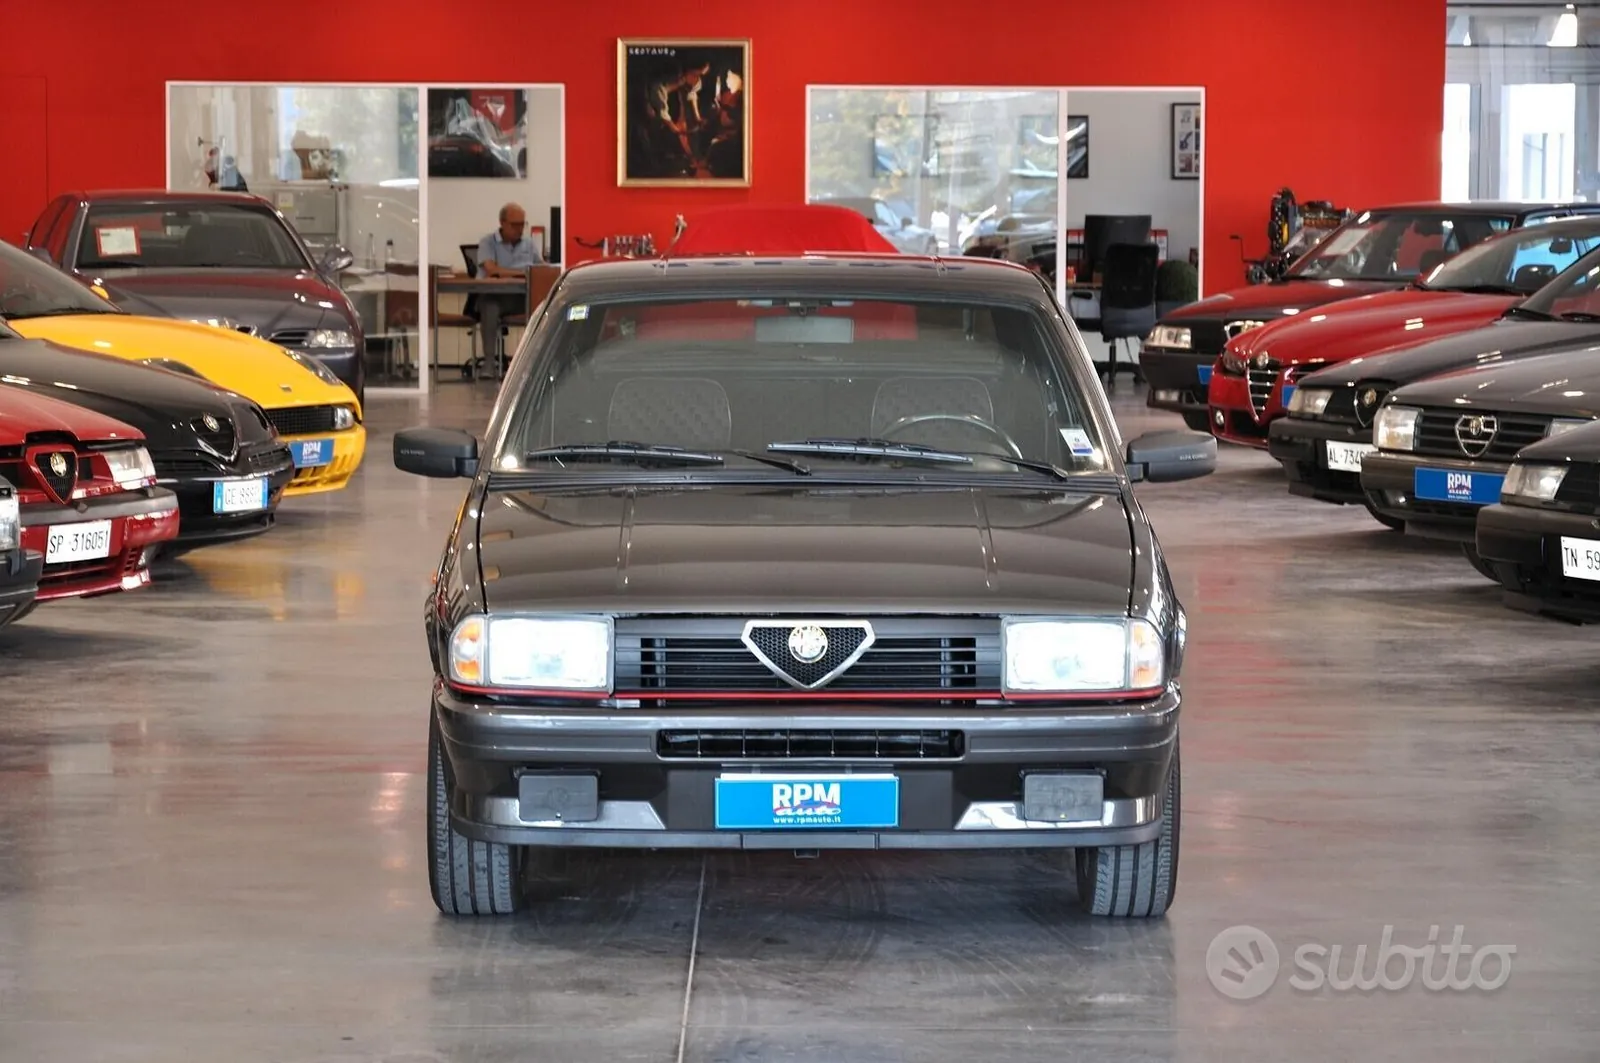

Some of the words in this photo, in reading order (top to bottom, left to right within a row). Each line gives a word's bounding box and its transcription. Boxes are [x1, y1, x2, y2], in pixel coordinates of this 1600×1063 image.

[301, 442, 321, 456] RPM
[1329, 447, 1338, 464] AL
[1447, 472, 1472, 490] RPM
[49, 534, 64, 554] SP
[71, 530, 108, 552] 316051
[1563, 547, 1578, 568] TN
[1586, 549, 1600, 571] 59
[772, 782, 841, 810] RPM
[775, 805, 842, 817] auto
[772, 816, 842, 825] www.rpmauto.it
